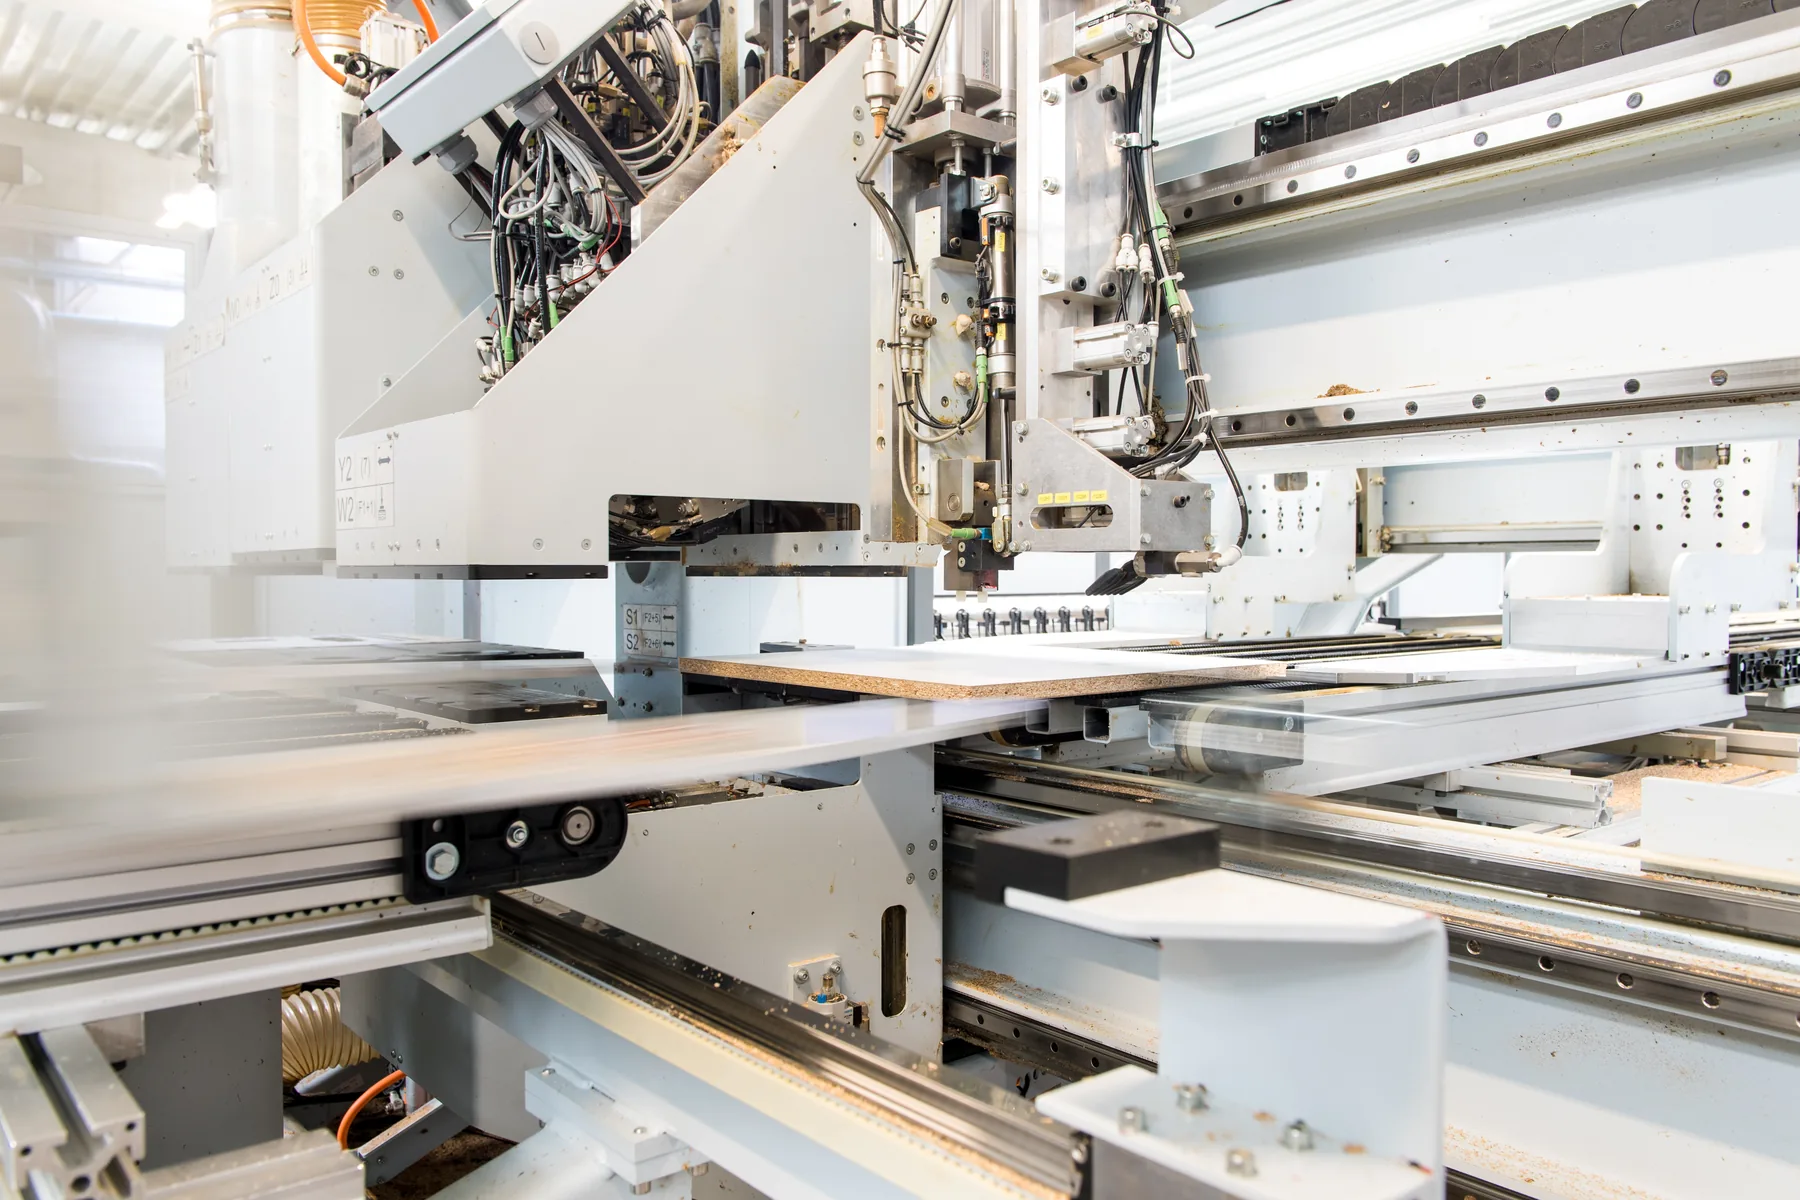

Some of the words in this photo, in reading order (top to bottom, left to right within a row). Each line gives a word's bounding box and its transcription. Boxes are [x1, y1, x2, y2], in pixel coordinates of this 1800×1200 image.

[338, 456, 352, 482] Y2
[360, 456, 371, 480] (7)
[337, 496, 354, 522] W2
[625, 608, 638, 625] S1
[643, 612, 661, 625] (F2+5)
[626, 633, 639, 650] S2
